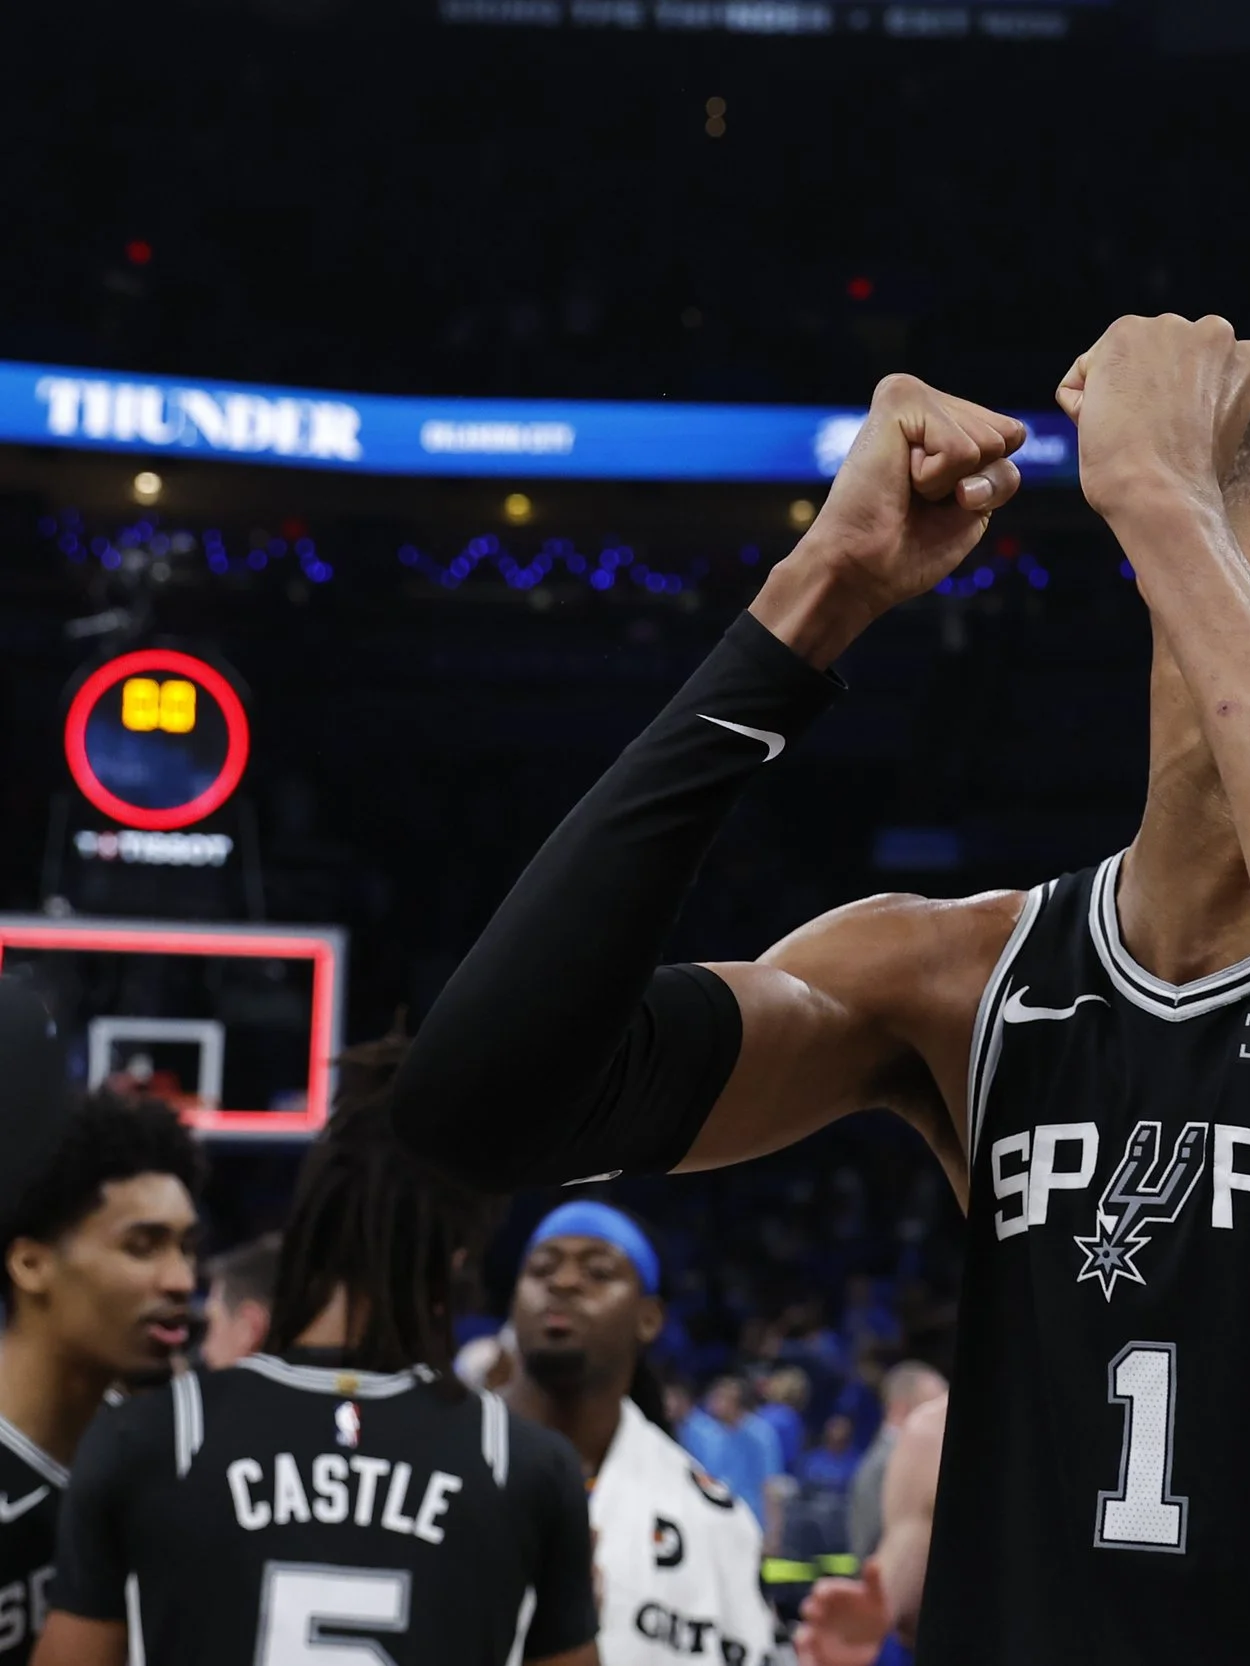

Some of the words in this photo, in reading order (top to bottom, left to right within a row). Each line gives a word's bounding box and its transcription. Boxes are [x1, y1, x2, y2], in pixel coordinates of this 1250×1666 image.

[35, 374, 364, 462] THUNDER
[1094, 1340, 1189, 1555] 1
[226, 1452, 463, 1544] CASTLE
